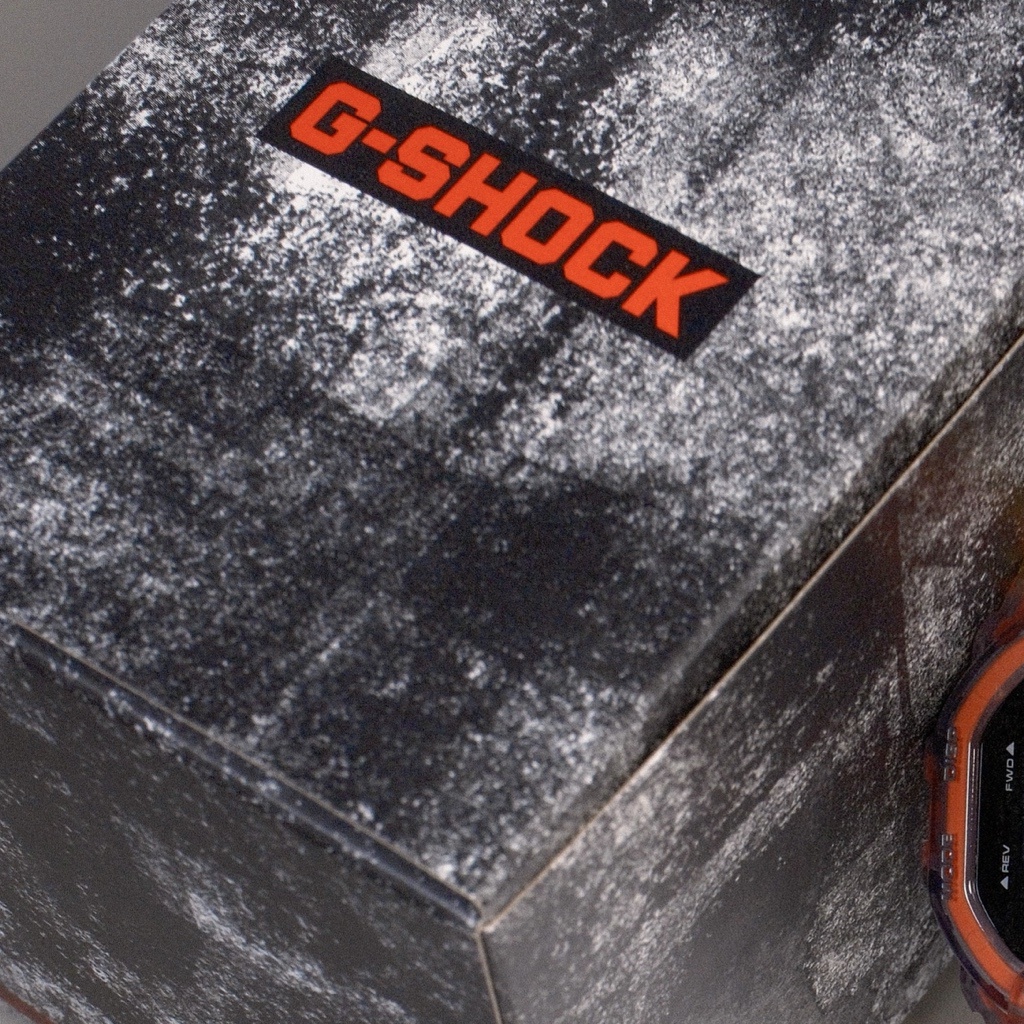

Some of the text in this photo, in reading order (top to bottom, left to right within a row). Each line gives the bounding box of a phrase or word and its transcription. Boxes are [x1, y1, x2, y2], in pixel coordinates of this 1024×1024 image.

[290, 82, 729, 339] G-SHOCK
[1005, 758, 1014, 792] FWD
[1001, 844, 1011, 873] REV
